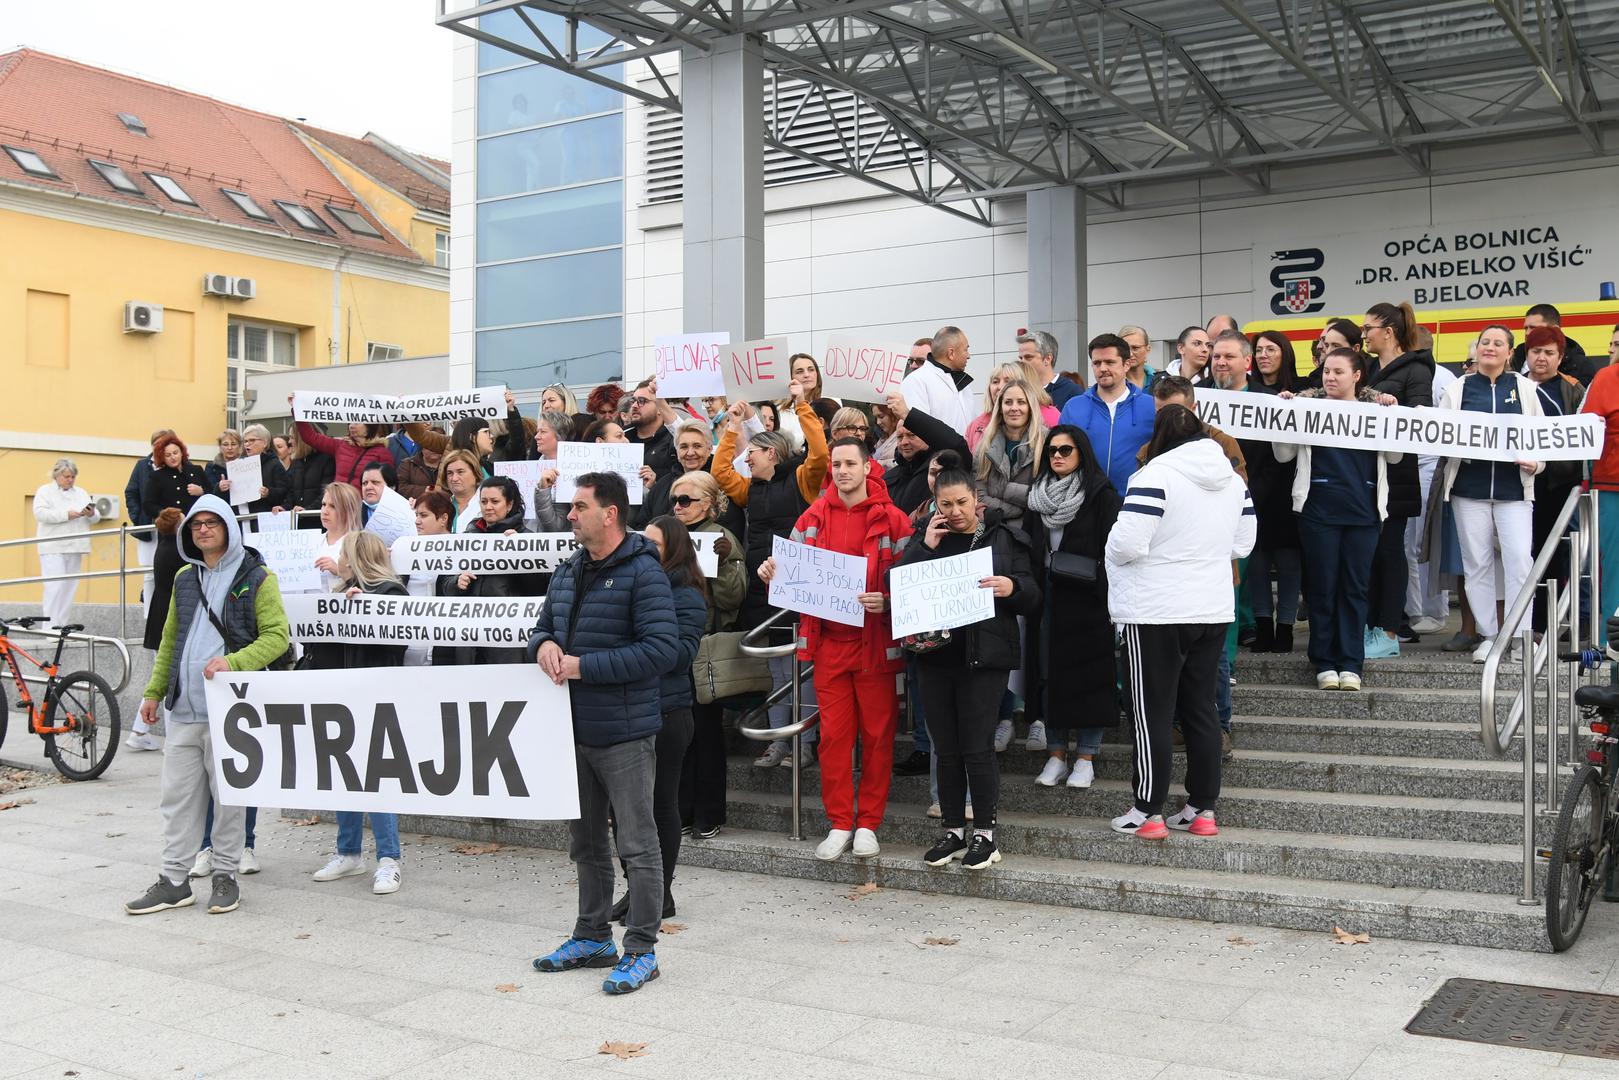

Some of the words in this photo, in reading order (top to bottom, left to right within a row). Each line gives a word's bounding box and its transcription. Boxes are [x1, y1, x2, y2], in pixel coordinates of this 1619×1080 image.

[1384, 234, 1447, 257] OPĆA
[1455, 226, 1559, 251] BOLNICA
[1405, 256, 1515, 280] ANĐELKO
[1415, 280, 1529, 304] BJELOVAR
[655, 341, 721, 380] BJELOVAR
[731, 346, 775, 386] NE
[825, 347, 908, 393] ODUSTAJE
[314, 396, 339, 407] AKO
[344, 398, 366, 408] IMA
[369, 400, 382, 409] ZA
[386, 393, 480, 409] NAORUŽANJE
[303, 410, 343, 421] TREBA
[346, 413, 379, 423] IMATI
[382, 415, 388, 423] I
[391, 414, 409, 423] ZA
[412, 407, 497, 422] ZDRAVSTVO
[1197, 400, 1221, 425] VA
[1229, 404, 1298, 432] TENKA
[1304, 411, 1376, 439] MANJE
[1383, 418, 1388, 439] I
[1395, 418, 1498, 449] PROBLEM
[1506, 422, 1595, 450] RIJEŠEN
[564, 445, 590, 457] PRED
[602, 447, 620, 458] TRI
[410, 540, 421, 552] U
[424, 539, 487, 552] BOLNICI
[494, 539, 550, 551] RADIM
[556, 539, 580, 551] PR
[775, 539, 823, 566] RADITE
[833, 554, 845, 569] LI
[411, 559, 420, 570] A
[425, 557, 453, 570] VAŠ
[458, 558, 549, 571] ODGOVOR
[900, 554, 973, 585] BURNOUT
[816, 569, 824, 585] 3
[827, 572, 863, 591] POSLA
[773, 586, 785, 595] ZA
[792, 588, 823, 606] JEDNU
[899, 593, 911, 608] JE
[931, 591, 989, 620] TURNOUT
[317, 599, 371, 615] BOJITE
[376, 600, 396, 615] SE
[401, 601, 519, 618] NUKLEARNOG
[297, 620, 334, 637] NAŠA
[338, 623, 375, 638] RADNA
[379, 625, 430, 640] MJESTA
[434, 627, 456, 641] DIO
[461, 628, 479, 642] SU
[484, 627, 513, 642] TOG
[221, 682, 531, 797] ŠTRAJK
